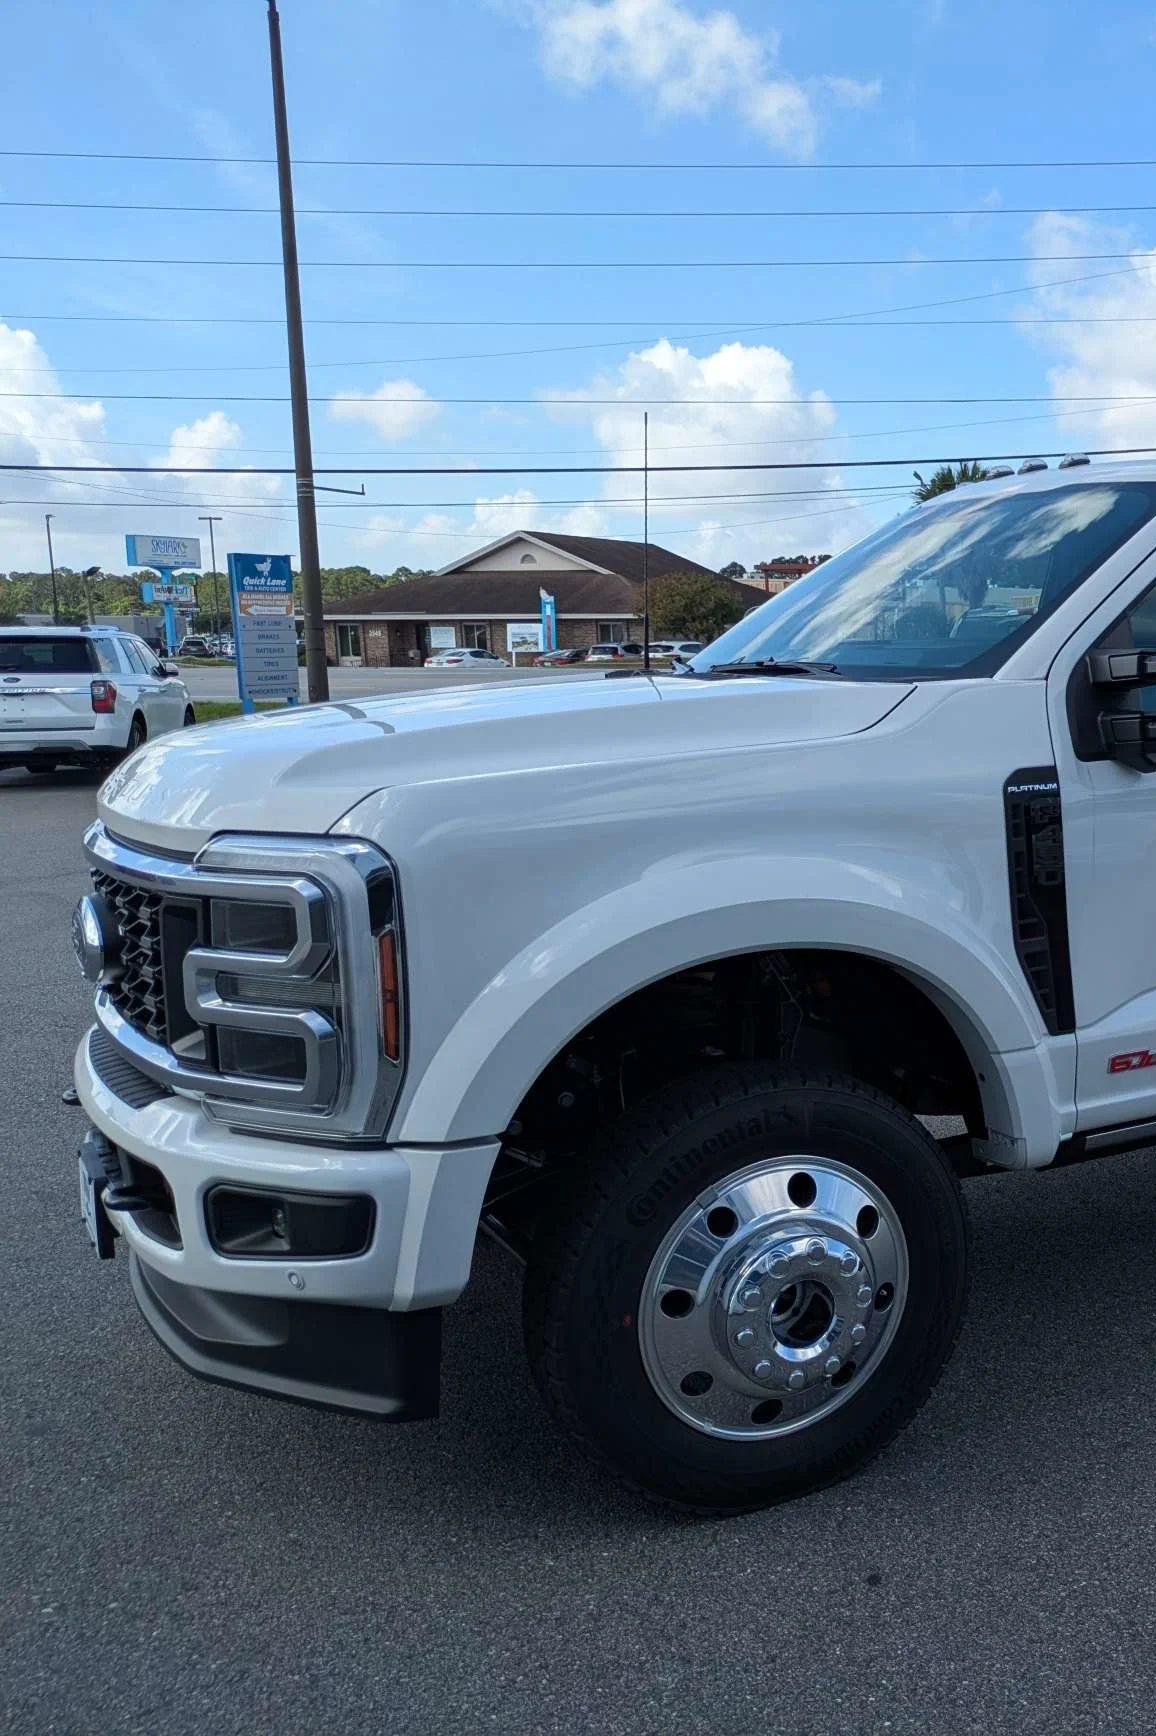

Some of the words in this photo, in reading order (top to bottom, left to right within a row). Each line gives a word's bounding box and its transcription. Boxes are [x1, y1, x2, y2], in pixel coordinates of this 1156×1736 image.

[243, 576, 266, 586] Quick
[267, 577, 287, 587] Lane
[257, 633, 280, 641] BRAKES
[255, 647, 286, 655] BATTERIES
[257, 674, 288, 682] ALIGNMENT
[1007, 783, 1057, 793] PLATINUM
[625, 1107, 769, 1226] Continental
